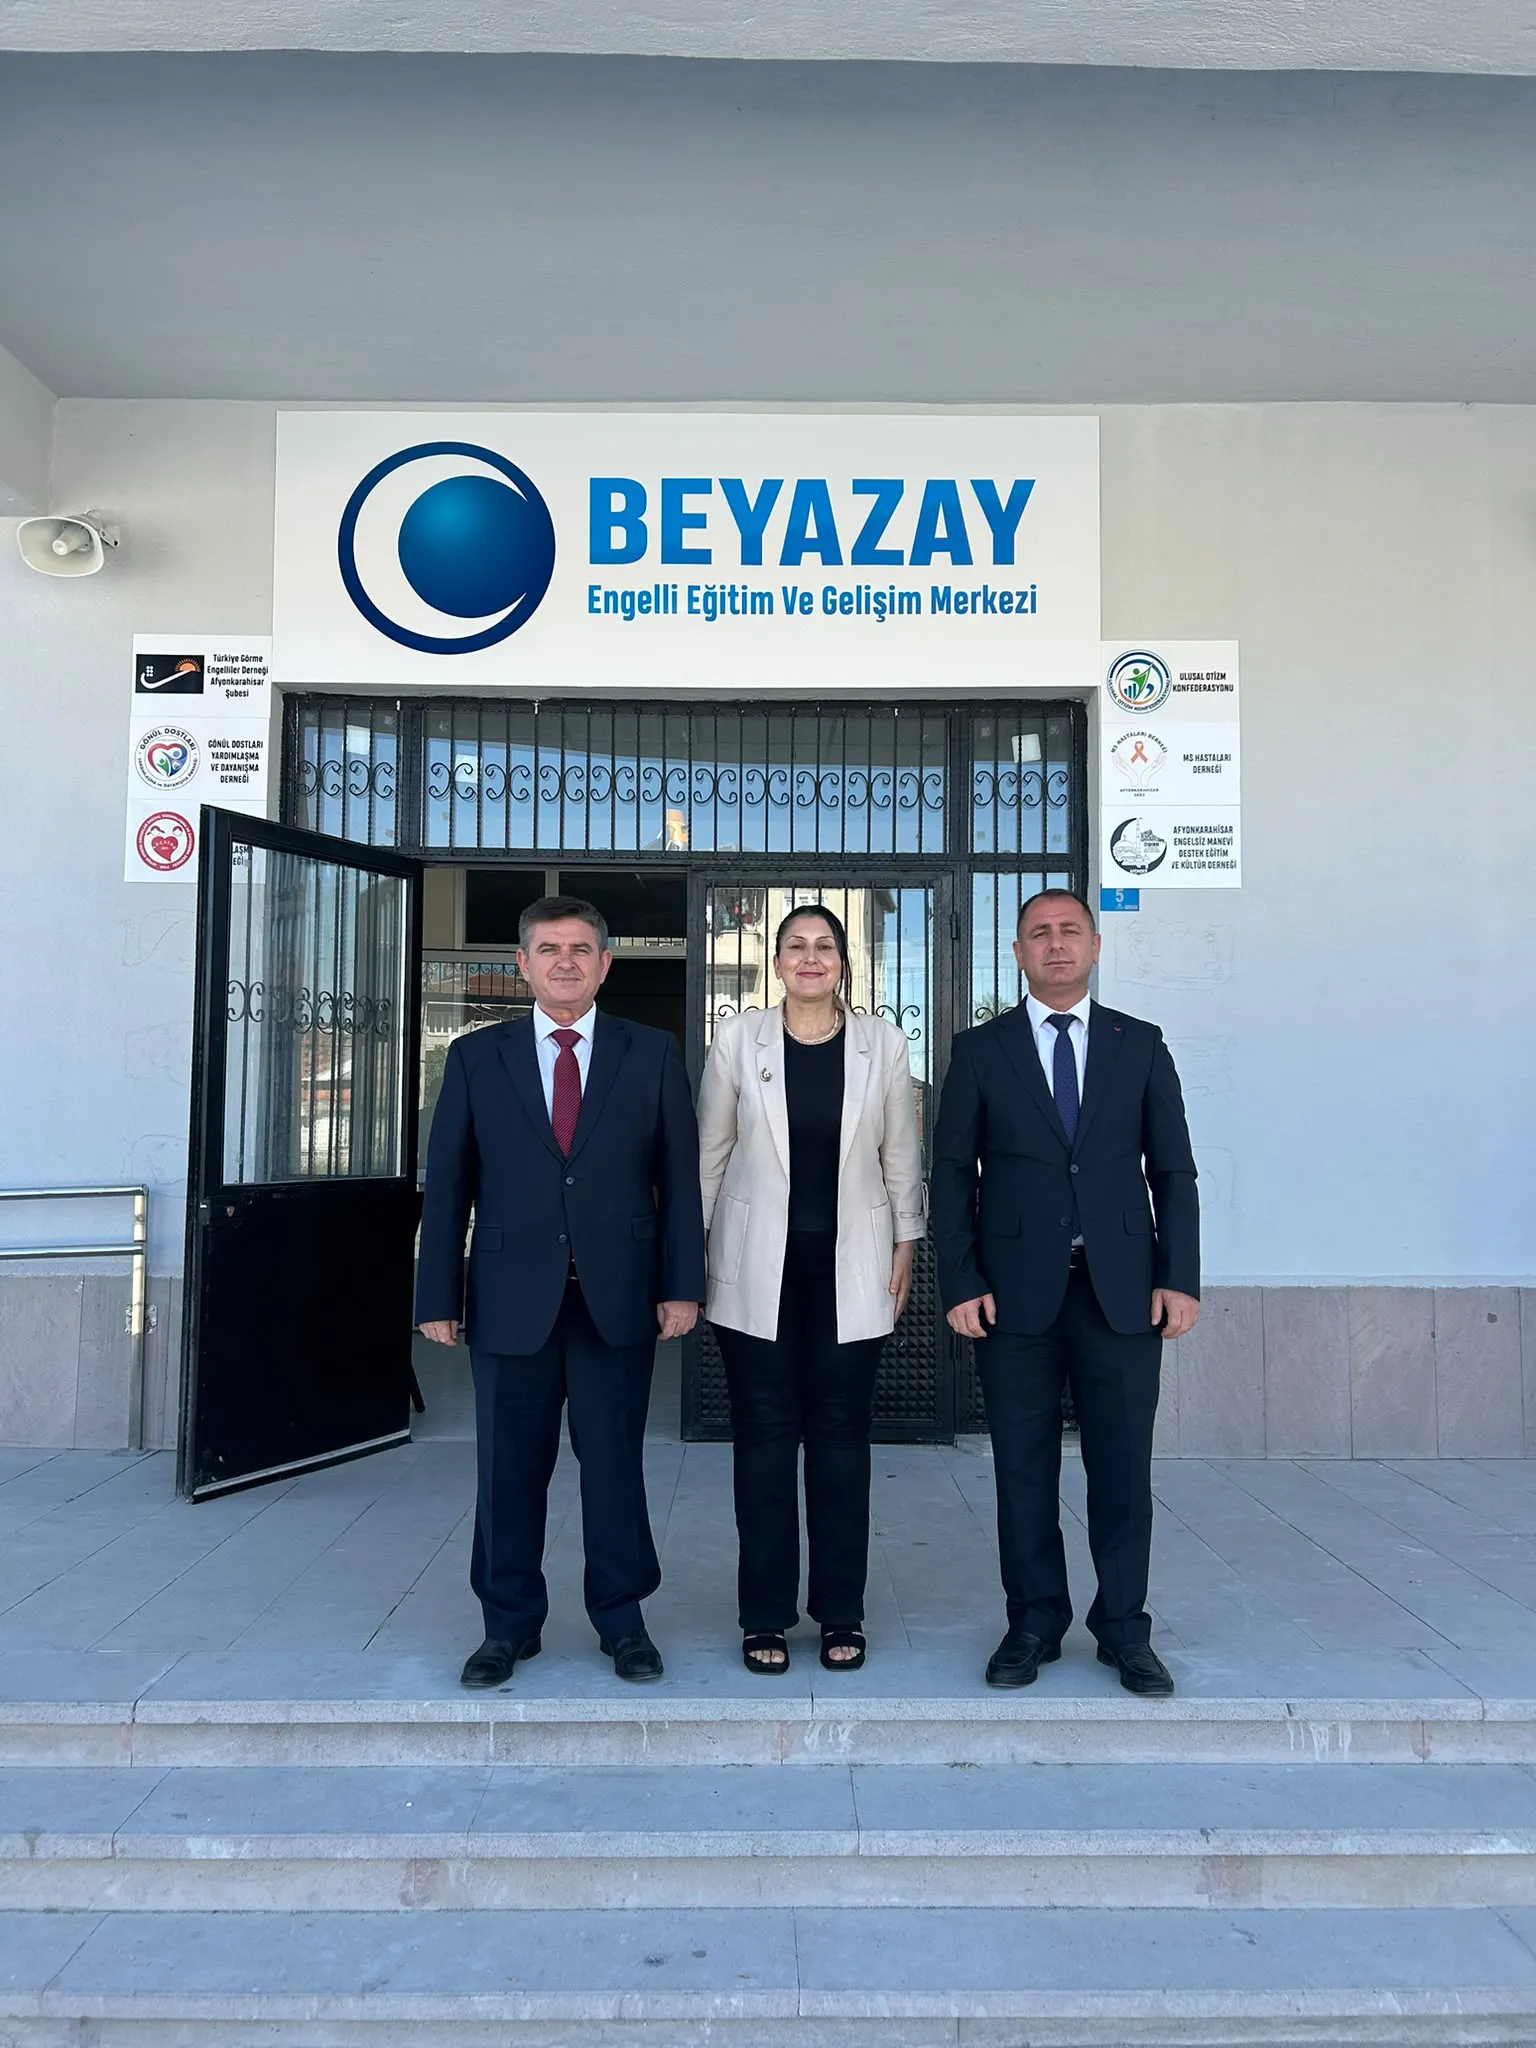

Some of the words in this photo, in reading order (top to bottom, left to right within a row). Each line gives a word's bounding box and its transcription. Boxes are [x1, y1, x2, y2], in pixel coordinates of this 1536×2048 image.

[589, 477, 1036, 566] BEYAZAY
[588, 584, 678, 621] Engelli
[687, 585, 774, 622] Eğitim
[782, 585, 814, 615] Ve
[822, 585, 921, 622] Gelişim
[931, 584, 1037, 614] Merkezi
[213, 654, 240, 664] Türkiye
[240, 654, 264, 663] Görme
[207, 665, 240, 676] Engelliler
[241, 666, 269, 676] Derneği
[1179, 672, 1205, 681] ULUSAL
[1205, 671, 1227, 681] OTİZM
[210, 677, 265, 687] Afyonkarahisar
[1172, 683, 1235, 692] KONFEDERASYONU
[225, 689, 249, 700] Şubesi
[164, 728, 197, 751] DOSTLARI
[1116, 731, 1148, 745] HASTALARI
[207, 738, 230, 748] GÖNÜL
[231, 740, 264, 749] DOSTLARI
[211, 751, 260, 762] YARDIMLAŞMA
[1182, 753, 1194, 762] MS
[1194, 753, 1232, 762] HASTALARI
[210, 763, 219, 772] VE
[220, 763, 260, 774] DAYANIŞMA
[1192, 764, 1222, 774] DERNEĞİ
[219, 774, 249, 784] DERNEĞİ
[1173, 824, 1234, 834] AFYONKARAHİSAR
[1173, 836, 1206, 846] ENGELSİZ
[1206, 836, 1233, 846] MANEVİ
[1178, 849, 1205, 858] DESTEK
[1205, 848, 1229, 858] EĞİTİM
[1180, 860, 1207, 870] KÜLTÜR
[1207, 860, 1237, 869] DERNEĞİ
[1115, 888, 1125, 903] 5
